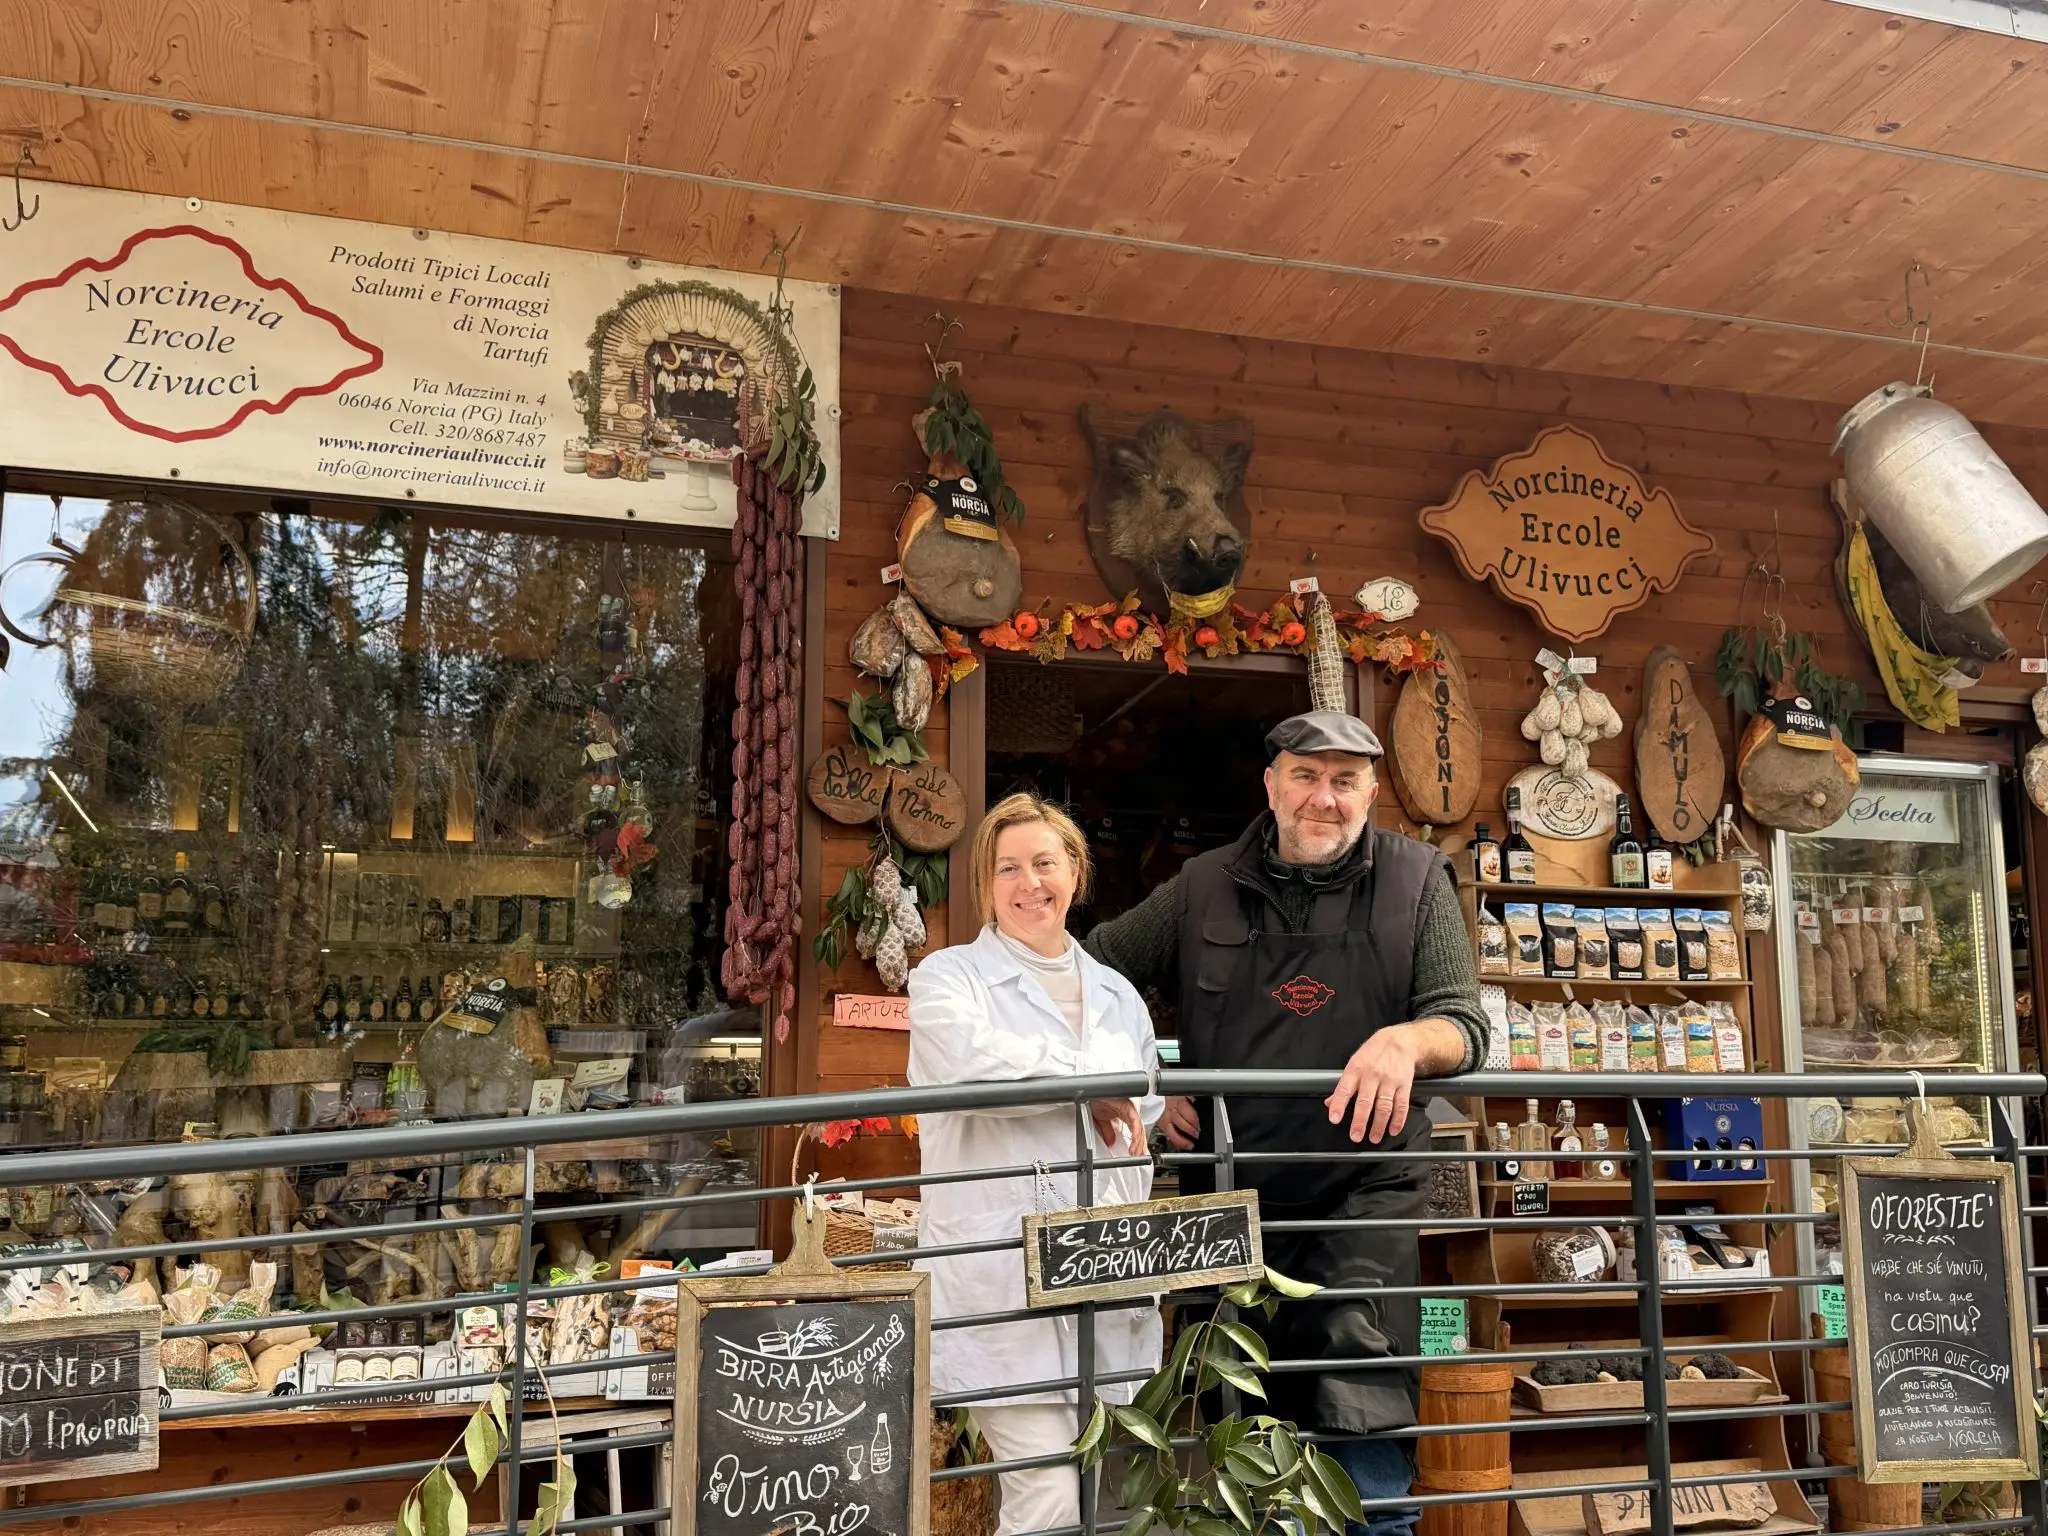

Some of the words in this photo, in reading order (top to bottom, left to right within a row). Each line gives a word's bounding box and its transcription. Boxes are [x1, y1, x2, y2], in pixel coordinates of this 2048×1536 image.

[328, 245, 416, 273] Prodotti
[423, 257, 480, 282] Tipici
[485, 265, 551, 289] Locali
[85, 279, 284, 330] Norcineria
[351, 275, 425, 301] Salumi
[430, 290, 443, 302] e
[448, 287, 550, 318] Formaggi
[124, 318, 235, 354] Ercole
[452, 316, 473, 333] di
[479, 317, 549, 340] Norcia
[483, 340, 549, 368] Tartufi
[103, 353, 260, 396] Ulivucci
[413, 377, 439, 395] Via
[445, 381, 511, 402] Mazzini
[515, 393, 531, 404] n.
[535, 393, 547, 407] 4
[338, 392, 392, 411] 06046
[396, 398, 457, 419] Norcia
[461, 404, 502, 425] (PG)
[508, 409, 548, 430] Italy
[389, 418, 429, 437] Cell.
[435, 423, 547, 448] 320/8687487
[318, 436, 547, 469] www.norcineriaulivucci.it
[317, 457, 547, 494] info@norcineriaulivucci.it
[952, 496, 990, 516] NORCIA
[1488, 465, 1644, 523] Norcineria
[1520, 512, 1621, 549] Ercole
[1500, 546, 1648, 597] Ulivucci
[1377, 585, 1404, 612] 18
[1786, 713, 1826, 730] NORCIA
[915, 766, 947, 798] del
[898, 787, 956, 830] Nonno
[1846, 795, 1937, 826] Scelta
[466, 995, 503, 1012] NORCIA
[1705, 1102, 1740, 1112] NURSIA
[1515, 1184, 1544, 1192] OFFERTA
[1057, 1226, 1086, 1246] €
[1099, 1218, 1151, 1246] 4.90
[1906, 1259, 1924, 1274] CHE
[1884, 1290, 1904, 1302] na
[1907, 1288, 1943, 1302] vistu
[1949, 1292, 1975, 1306] que
[89, 1357, 121, 1385] DI
[715, 1349, 801, 1390] BIRRA
[803, 1314, 905, 1402] Artigianale
[1892, 1346, 1939, 1366] COMPRA
[1944, 1350, 1971, 1369] QUE
[1900, 1381, 1919, 1390] CARO
[730, 1392, 845, 1426] NURSIA
[1879, 1405, 1904, 1417] GRAZIE
[1905, 1405, 1922, 1414] PER
[1930, 1404, 1949, 1413] TUOI
[1936, 1420, 1943, 1428] A
[61, 1413, 150, 1450] PROPRIA
[1896, 1436, 1906, 1446] LA
[1909, 1431, 1945, 1445] NOSTRA
[1948, 1429, 2002, 1449] NORCIA
[710, 1454, 840, 1518] Vino
[773, 1502, 870, 1536] Bio
